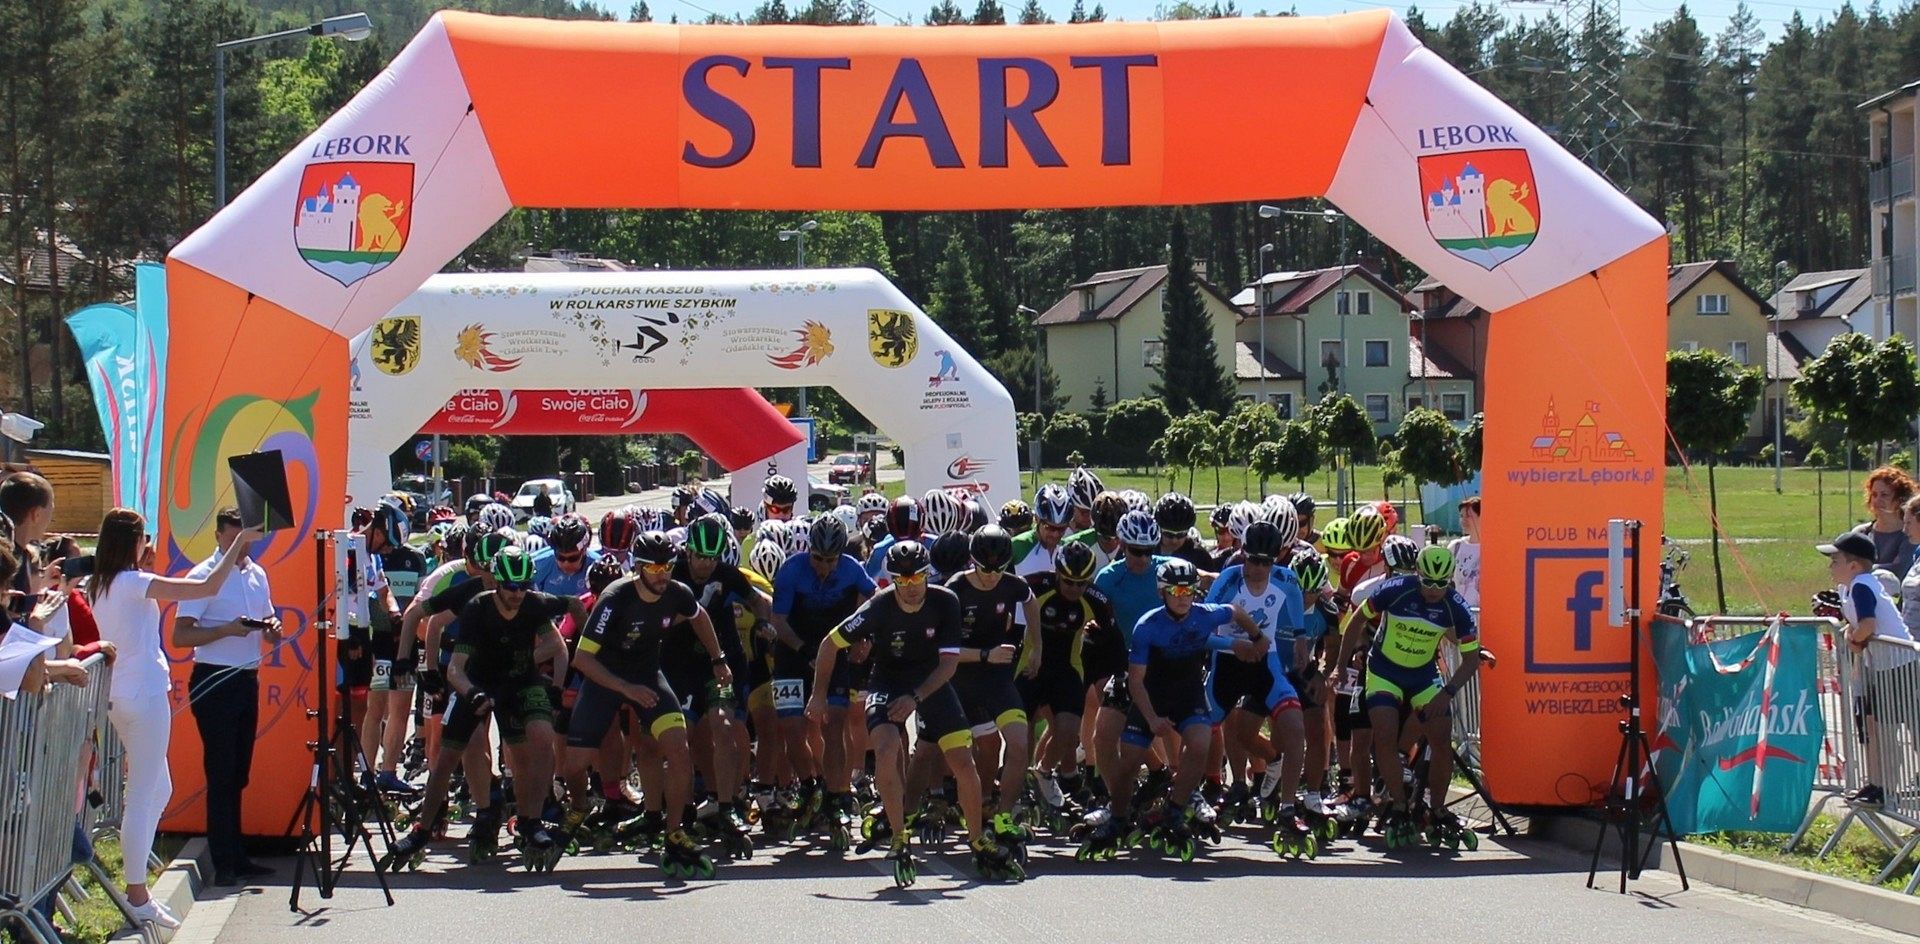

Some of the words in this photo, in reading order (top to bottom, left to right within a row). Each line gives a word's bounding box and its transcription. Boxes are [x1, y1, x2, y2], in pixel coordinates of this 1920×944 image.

[681, 53, 1158, 169] START
[1418, 124, 1519, 151] LĘBORK
[312, 135, 412, 159] LĘBORK
[581, 287, 642, 295] PUCHAR
[645, 286, 704, 294] KASZUB
[550, 300, 565, 309] W
[566, 299, 670, 309] ROLKARSTWIE
[674, 299, 737, 308] SZYBKIM
[461, 397, 499, 411] Ciało
[542, 397, 586, 412] Swoje
[591, 396, 629, 410] Ciało
[1507, 468, 1655, 486] wybierzLębork.pl
[1527, 527, 1578, 541] POLUB
[595, 607, 612, 634] uvex
[844, 614, 865, 633] uvex
[773, 685, 801, 700] 244
